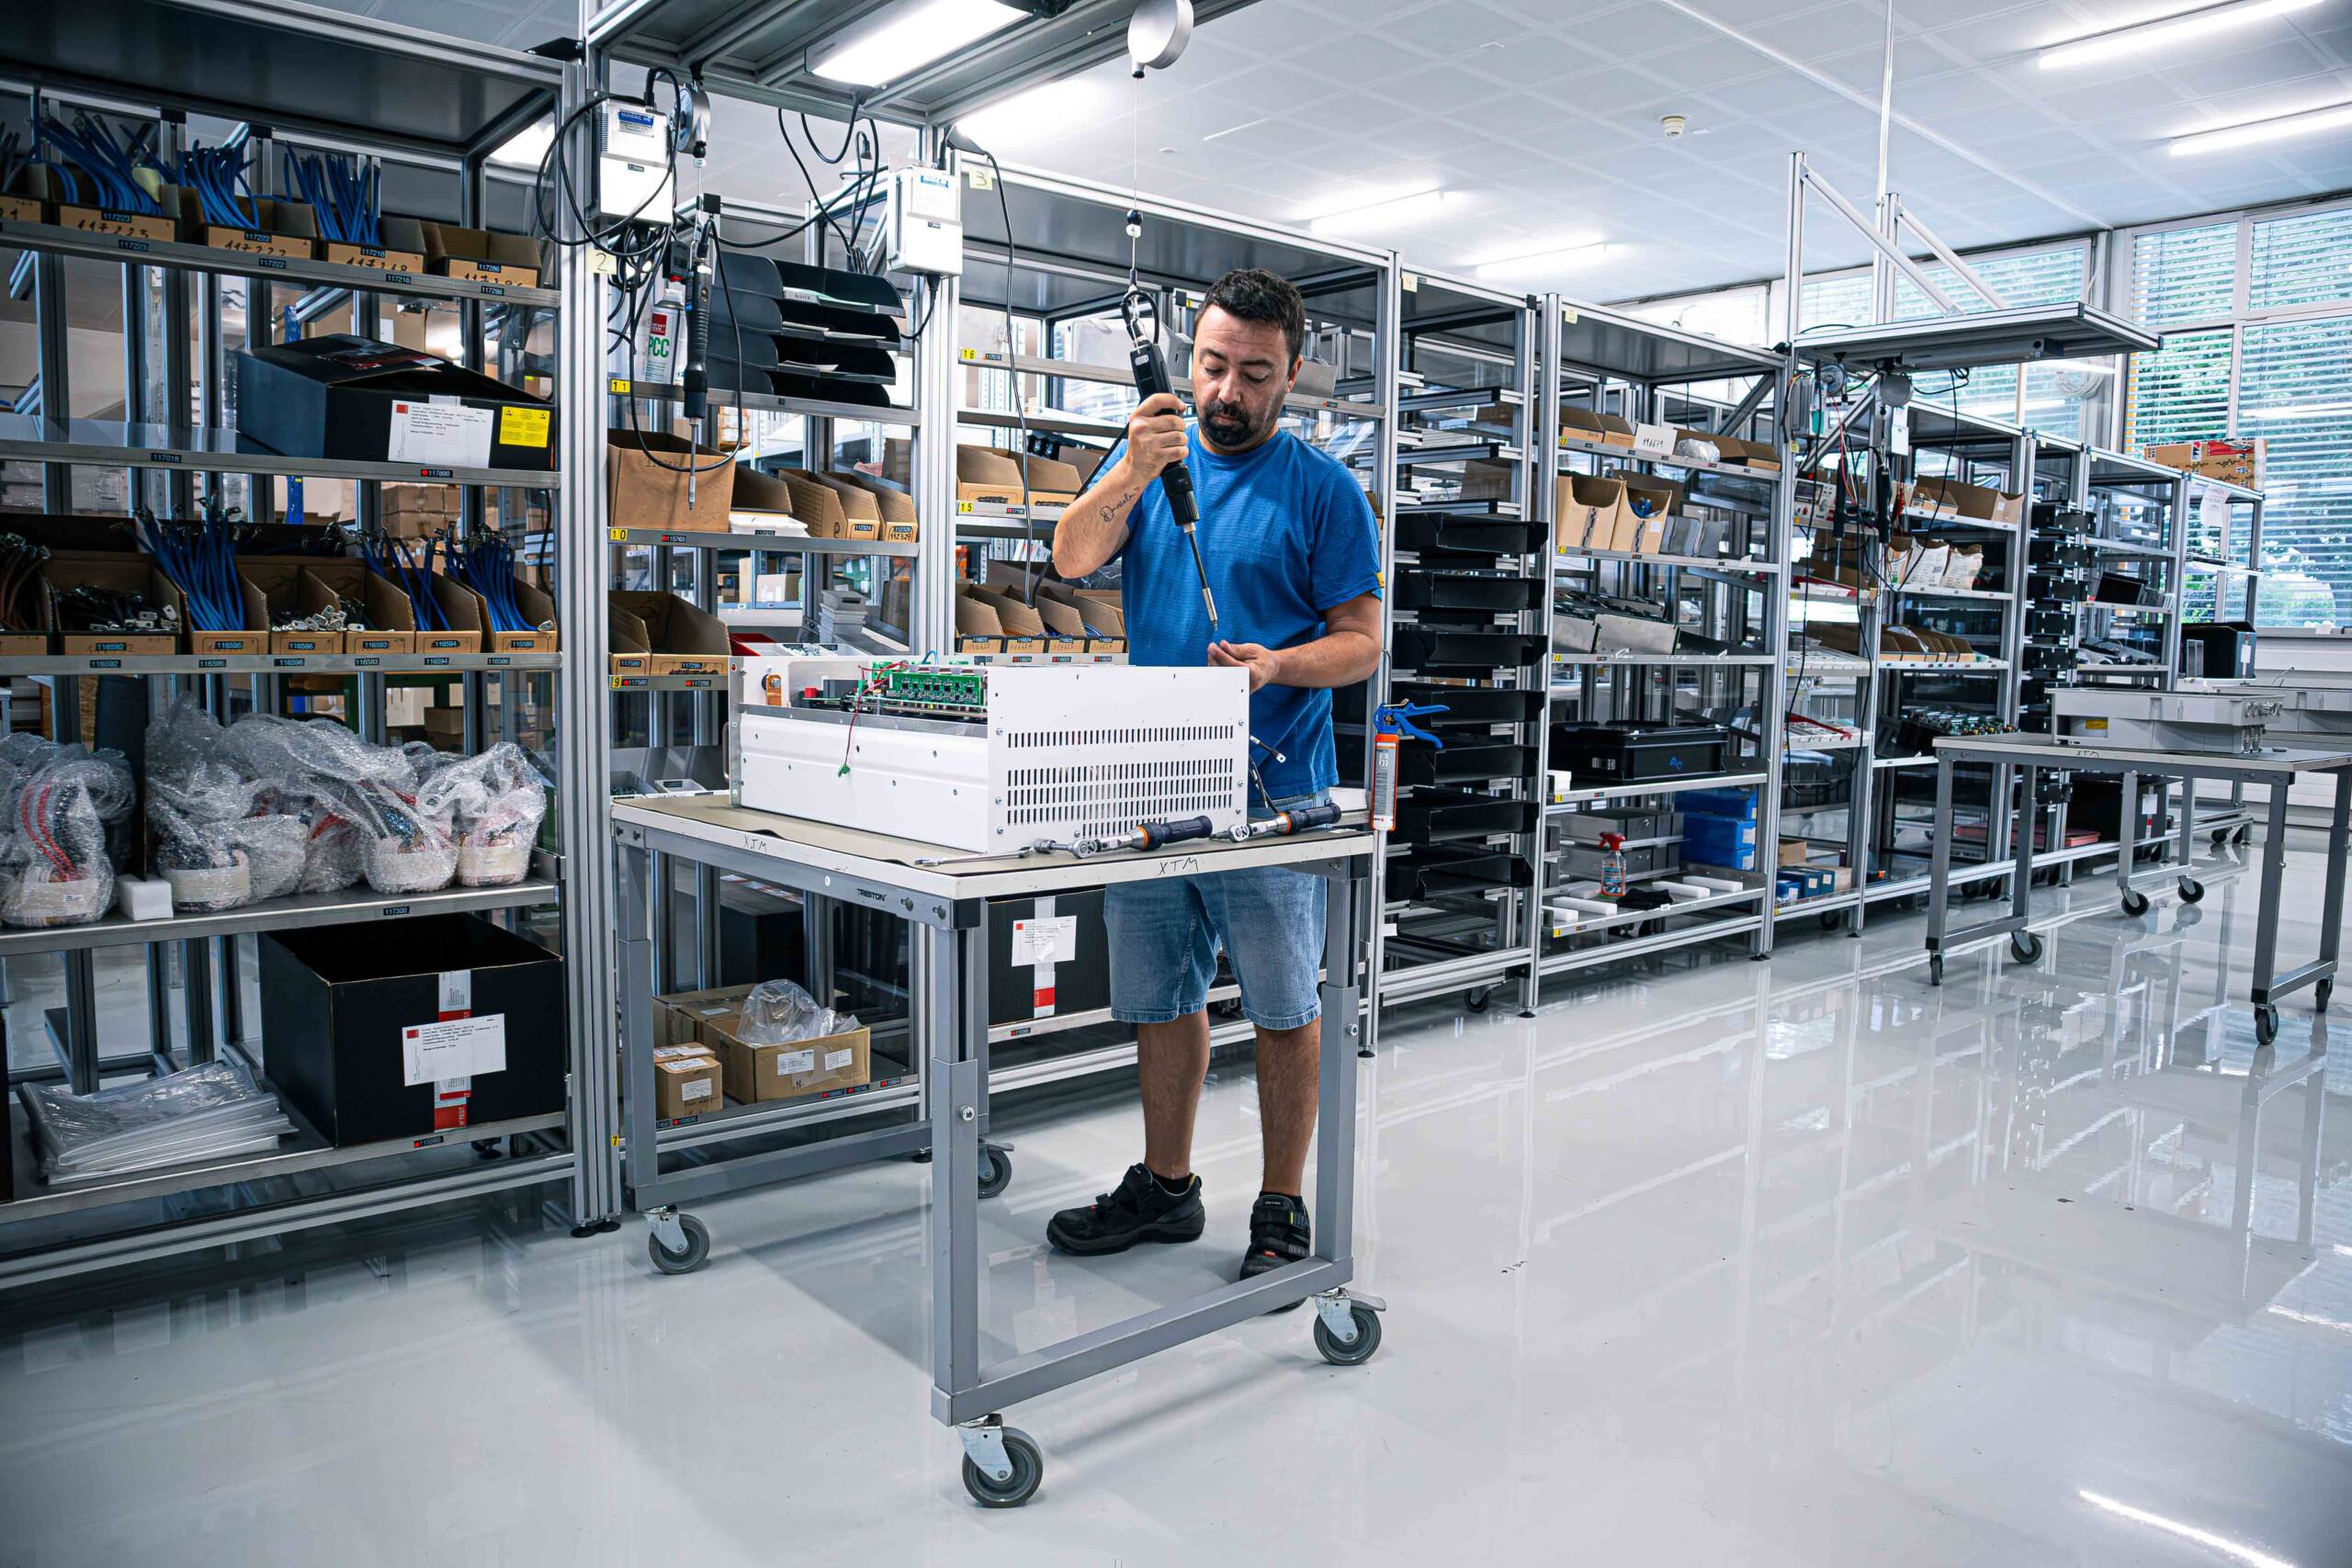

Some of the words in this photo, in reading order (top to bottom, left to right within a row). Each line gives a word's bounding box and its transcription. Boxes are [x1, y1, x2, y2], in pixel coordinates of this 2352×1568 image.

[977, 171, 987, 186] 3
[595, 253, 607, 271] 2
[649, 337, 670, 358] PCC
[613, 529, 626, 540] 10
[614, 677, 620, 687] 9
[1159, 857, 1199, 875] XTM
[612, 1136, 617, 1145] 7
